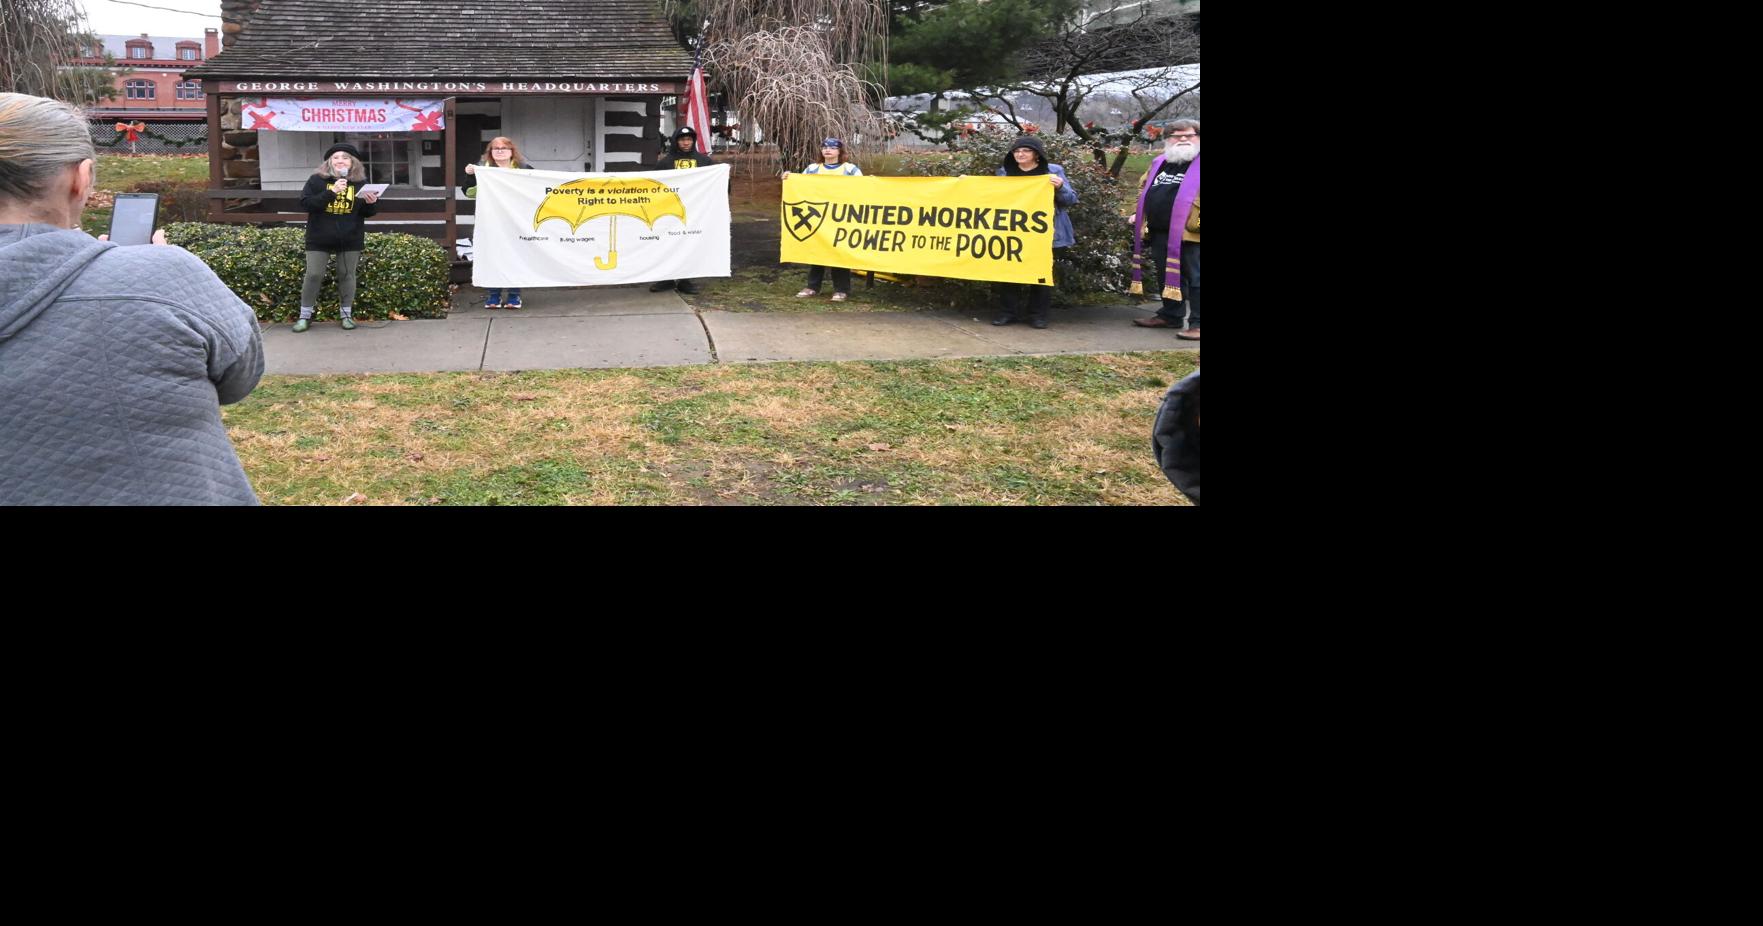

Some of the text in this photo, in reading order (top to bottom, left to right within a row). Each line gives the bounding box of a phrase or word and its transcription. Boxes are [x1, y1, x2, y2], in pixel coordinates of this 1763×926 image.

[236, 82, 660, 92] GEORGE WASHINGTON'S HEADQUARTERS
[301, 108, 387, 123] CHRISTMAS
[545, 187, 584, 196] Poverty
[607, 186, 649, 194] violation
[651, 186, 661, 194] of
[578, 197, 604, 206] Right
[619, 196, 651, 205] Health
[831, 203, 1049, 234] UNITED WORKERS
[832, 227, 1023, 262] POWER TO THE POOR
